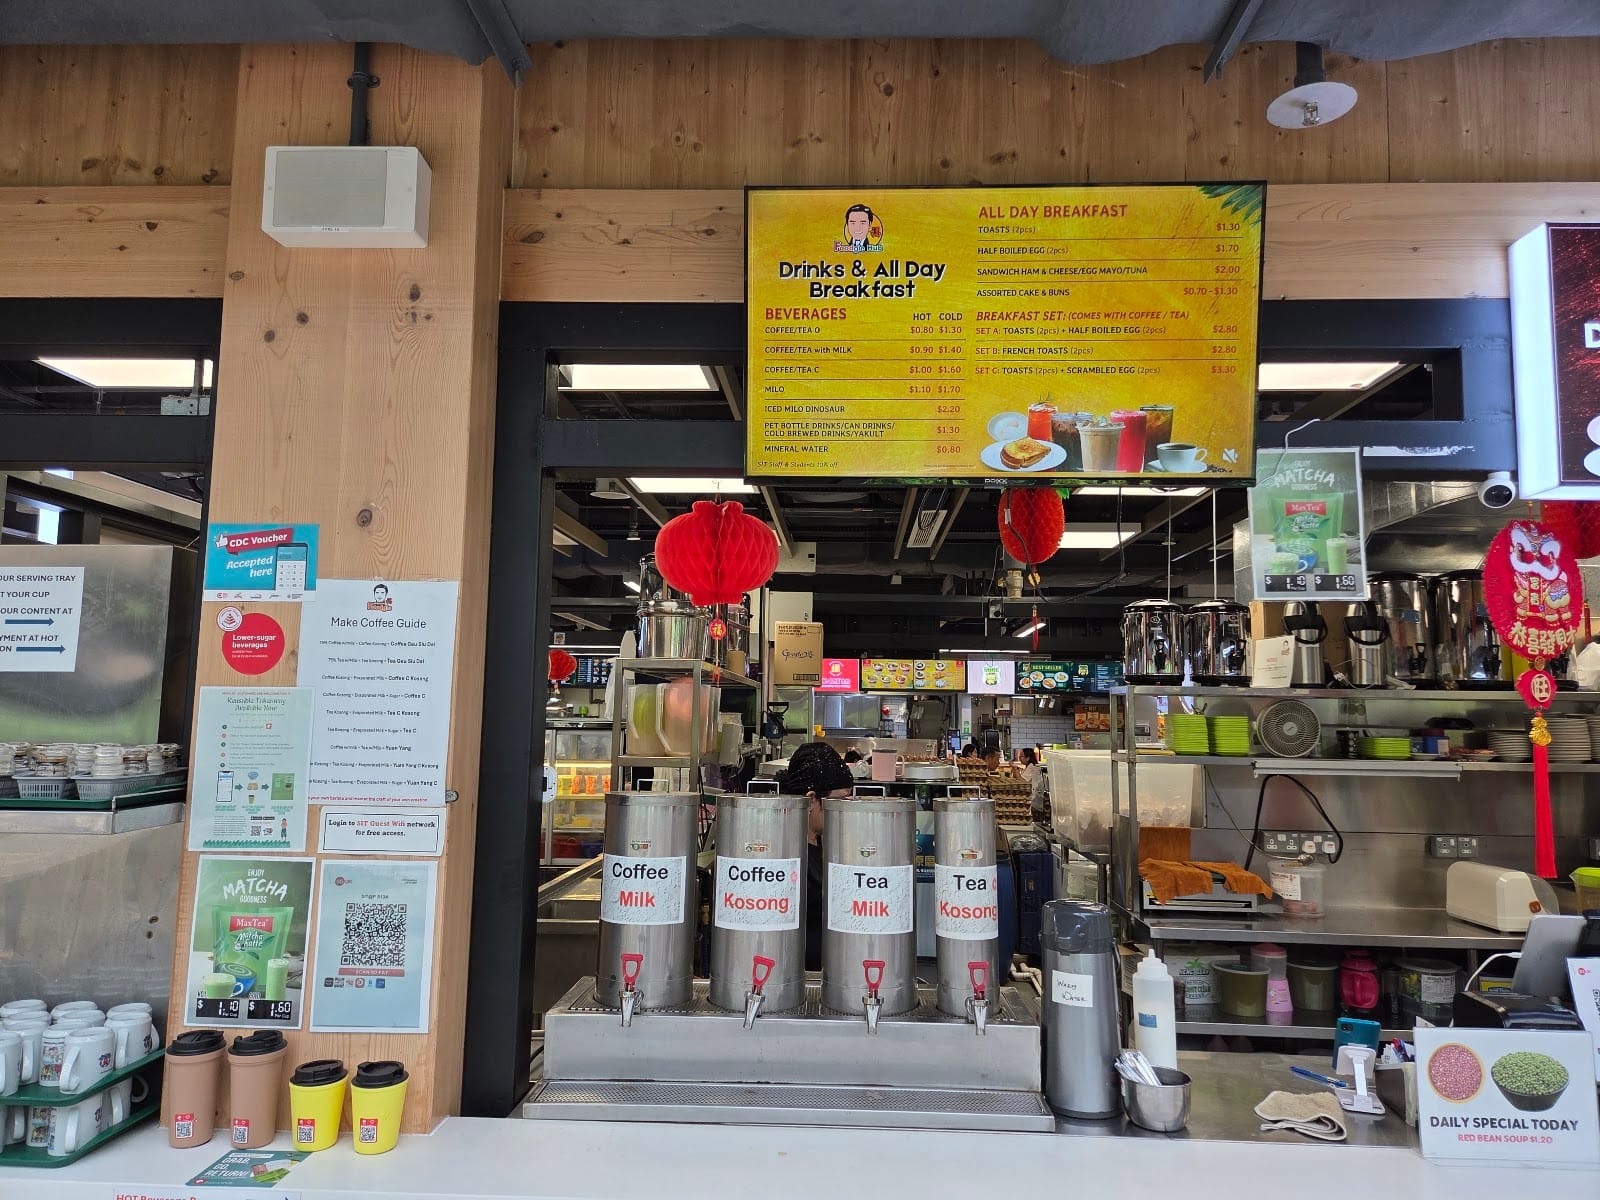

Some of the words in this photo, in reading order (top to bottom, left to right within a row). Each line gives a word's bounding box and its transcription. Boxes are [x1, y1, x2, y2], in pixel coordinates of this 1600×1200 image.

[979, 206, 1004, 219] ALL
[1010, 206, 1037, 218] DAY
[1044, 204, 1128, 218] BREAKFAST
[978, 226, 1010, 234] TOASTS
[1012, 226, 1036, 235] (2pcs)
[1216, 222, 1240, 232] $1.30
[978, 247, 997, 255] HALF
[1030, 246, 1045, 254] EGG
[1046, 246, 1069, 256] (2pcs)
[1216, 244, 1239, 253] $1.70
[779, 261, 844, 278] Drinks
[852, 260, 866, 278] &
[874, 260, 899, 278] All
[905, 261, 946, 282] Day
[977, 268, 1020, 276] SANDWICH
[1021, 268, 1040, 276] HAM
[1049, 267, 1097, 275] CHEESE/EGG
[1099, 267, 1147, 275] MAYO/TUNA
[1215, 265, 1240, 274] $2.00
[809, 280, 915, 298] Breakfast
[976, 289, 1016, 297] ASSORTED
[1048, 288, 1070, 296] BUNS
[1184, 287, 1207, 296] $0.70
[1214, 286, 1238, 296] $1.30
[766, 308, 847, 320] BEVERAGES
[976, 311, 1040, 321] BREAKFAST
[1043, 311, 1066, 321] SET:
[1068, 311, 1101, 320] (COMES
[1104, 311, 1126, 320] WITH
[1129, 311, 1161, 320] COFFEE
[1170, 311, 1190, 320] TEA)
[765, 326, 812, 334] COFFEE/TEA
[910, 326, 934, 334] $0.80
[939, 326, 962, 334] $1.30
[976, 327, 990, 335] SET
[992, 327, 1001, 335] A:
[1003, 327, 1034, 335] TOASTS
[1036, 326, 1059, 336] (2pcs)
[1068, 326, 1089, 334] HALF
[1092, 326, 1122, 334] BOILED
[1124, 326, 1140, 334] EGG
[1142, 326, 1166, 335] (2pcs)
[1213, 325, 1237, 334] $2.80
[765, 346, 812, 354] COFFEE/TEA
[814, 346, 831, 354] with
[833, 346, 852, 354] MILK
[910, 346, 934, 354] $0.90
[938, 346, 962, 354] $1.40
[976, 347, 990, 355] SET
[992, 347, 1000, 355] B:
[1070, 346, 1094, 355] (2pcs)
[1212, 346, 1237, 355] $2.80
[765, 366, 812, 374] COFFEE/TEA
[814, 366, 820, 374] C
[909, 366, 931, 374] $1.00
[938, 366, 961, 374] $1.60
[975, 366, 990, 374] SET
[992, 366, 1000, 374] C:
[1002, 366, 1033, 374] TOASTS
[1035, 366, 1058, 375] (2pcs)
[1066, 366, 1116, 374] SCRAMBLED
[1118, 366, 1135, 374] EGG
[1137, 366, 1160, 375] (2pcs)
[1211, 365, 1236, 374] $3.30
[812, 422, 860, 430] DRINKS/CAN
[862, 422, 895, 430] DRINKS/
[937, 426, 960, 434] $1.30
[822, 430, 884, 438] DRINKS/YAKULT
[1274, 468, 1335, 488] MATCHA
[229, 538, 249, 547] CDC
[251, 534, 287, 544] Voucher
[226, 556, 273, 569] Accepted
[250, 568, 272, 578] here
[331, 617, 358, 627] Make
[361, 618, 394, 628] Coffee
[396, 618, 427, 629] Guide
[328, 819, 347, 828] Login
[248, 869, 264, 877] ENJOY
[612, 863, 668, 880] Coffee
[728, 865, 785, 883] Coffee
[854, 872, 888, 889] Tea
[953, 875, 986, 891] Tea
[223, 878, 288, 901] MATCHA
[240, 895, 267, 904] GOODNESS
[619, 891, 655, 907] Milk
[724, 893, 789, 914] Kosong
[852, 900, 890, 917] Milk
[940, 900, 997, 920] Kosong
[197, 1000, 203, 1009] $
[248, 1002, 254, 1010] $
[1430, 1116, 1470, 1128] DAILY
[1473, 1117, 1529, 1130] SPECIAL
[1532, 1119, 1578, 1132] TODAY
[1458, 1134, 1476, 1142] RED
[1477, 1134, 1502, 1142] BEAN
[1504, 1135, 1528, 1143] SOUP
[1530, 1135, 1553, 1144] $1.20
